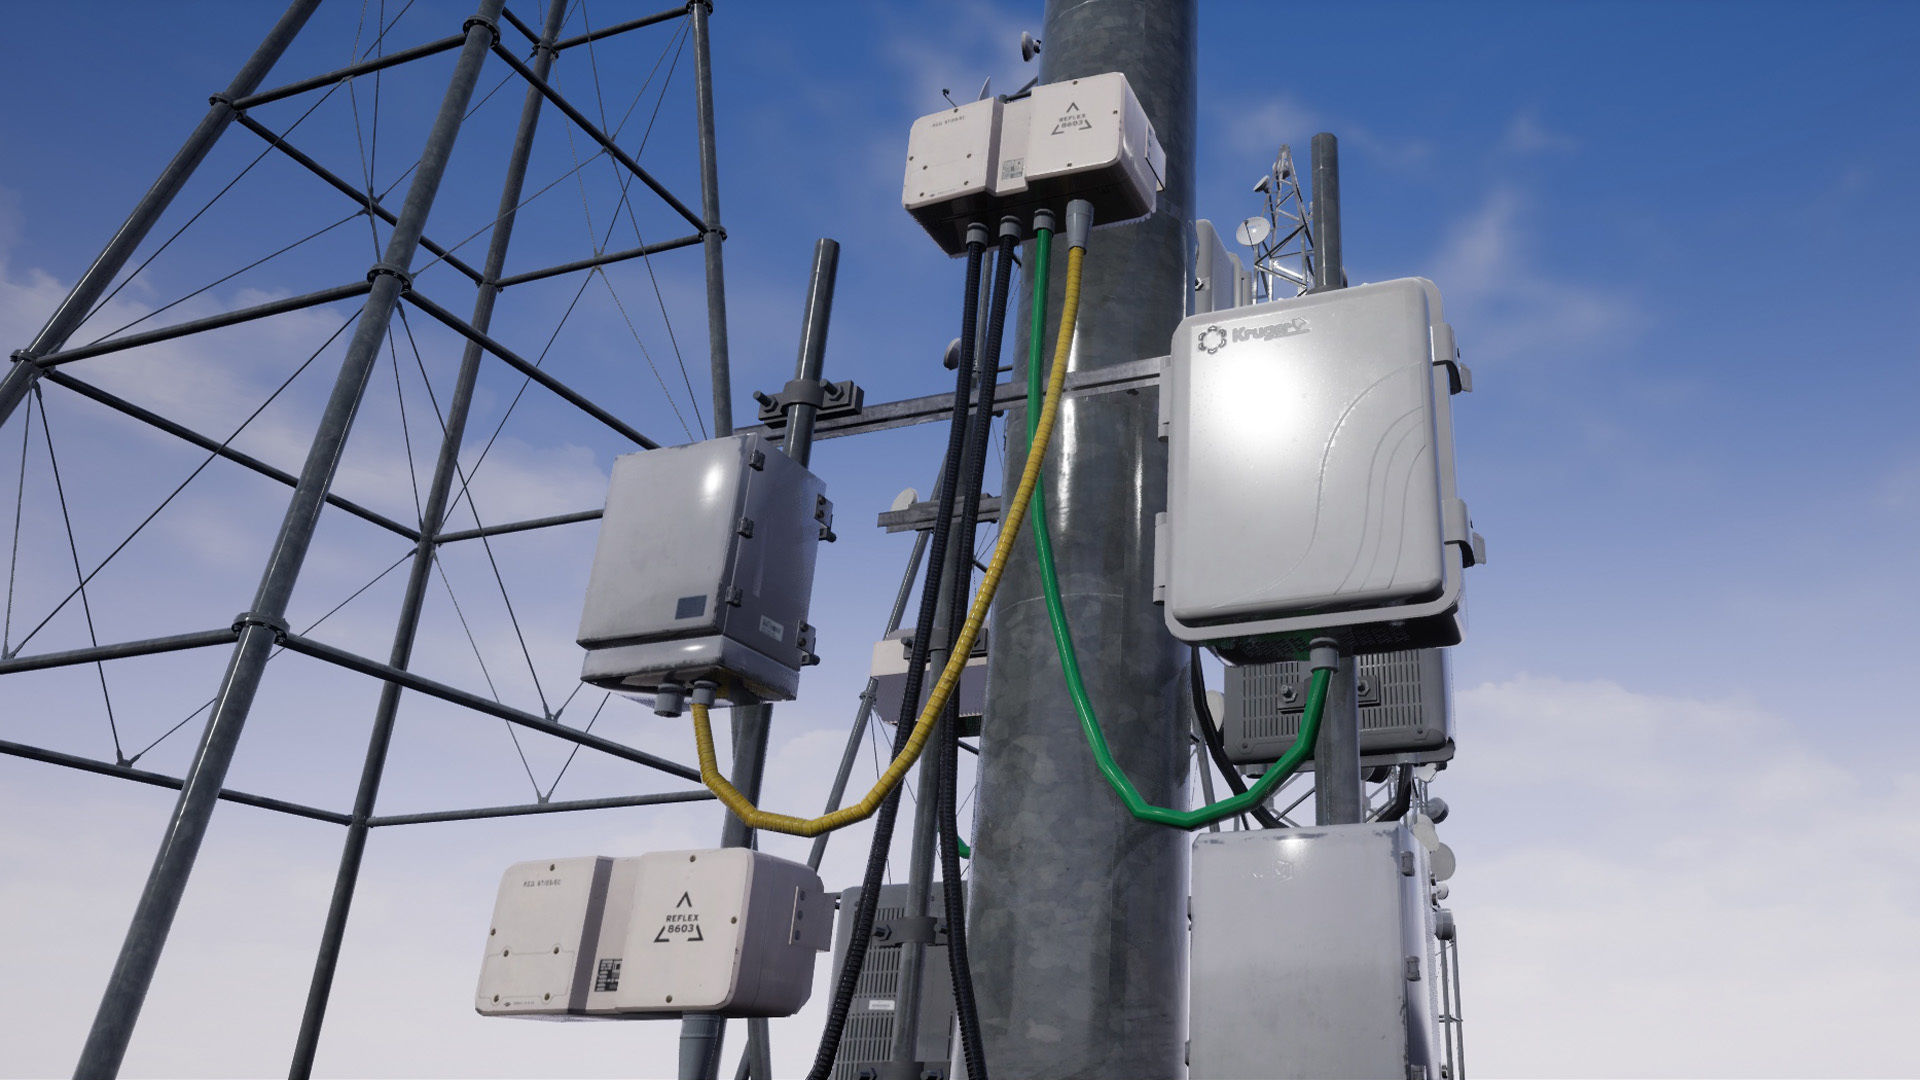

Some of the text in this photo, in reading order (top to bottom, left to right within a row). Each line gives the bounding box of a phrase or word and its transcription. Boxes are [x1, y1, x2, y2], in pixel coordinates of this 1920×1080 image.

[1232, 322, 1293, 342] Kruger
[666, 914, 699, 922] REFLEX
[667, 924, 695, 933] 8603
